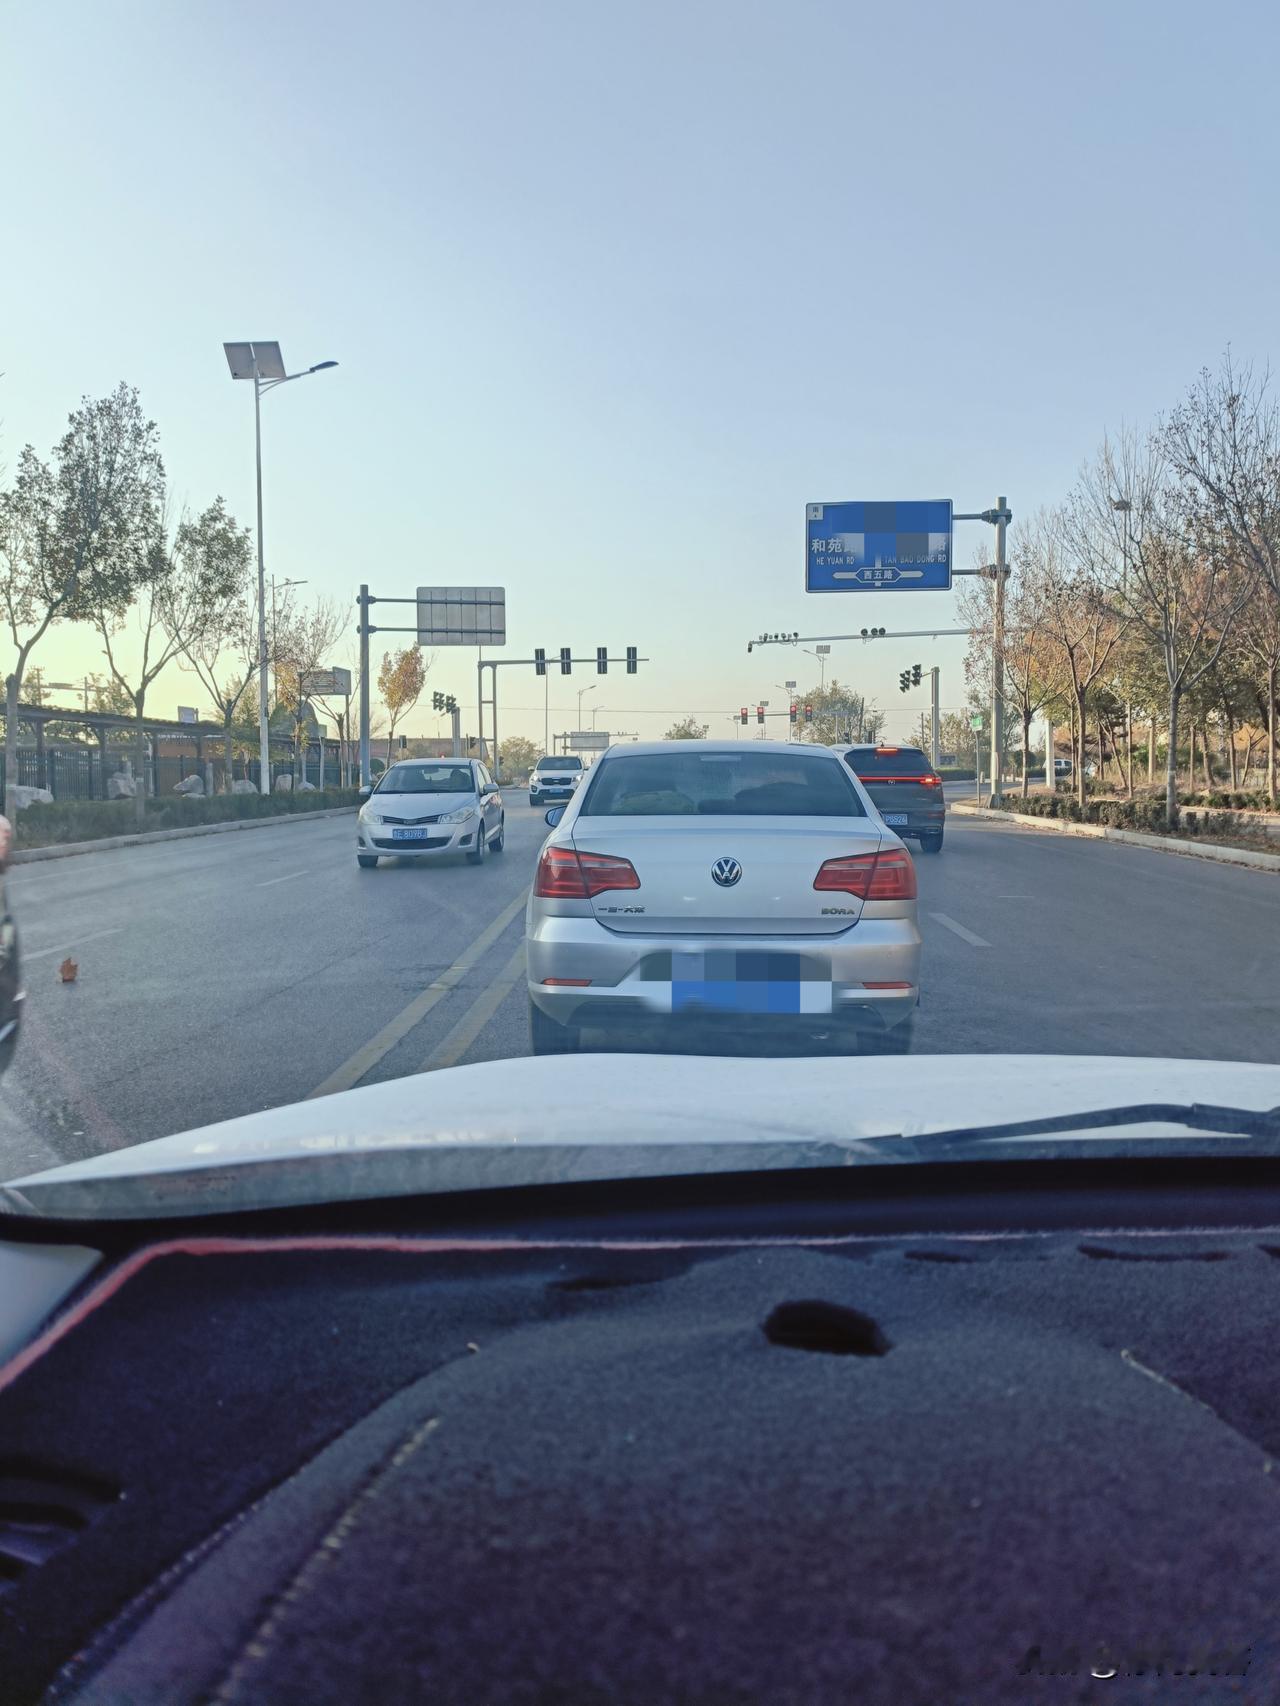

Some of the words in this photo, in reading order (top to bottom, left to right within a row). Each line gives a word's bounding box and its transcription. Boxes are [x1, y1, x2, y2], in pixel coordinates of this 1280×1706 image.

[816, 556, 825, 565] HE
[827, 556, 844, 565] YUAN
[846, 556, 855, 565] RD
[937, 554, 947, 563] RD
[863, 570, 893, 580] 西五路
